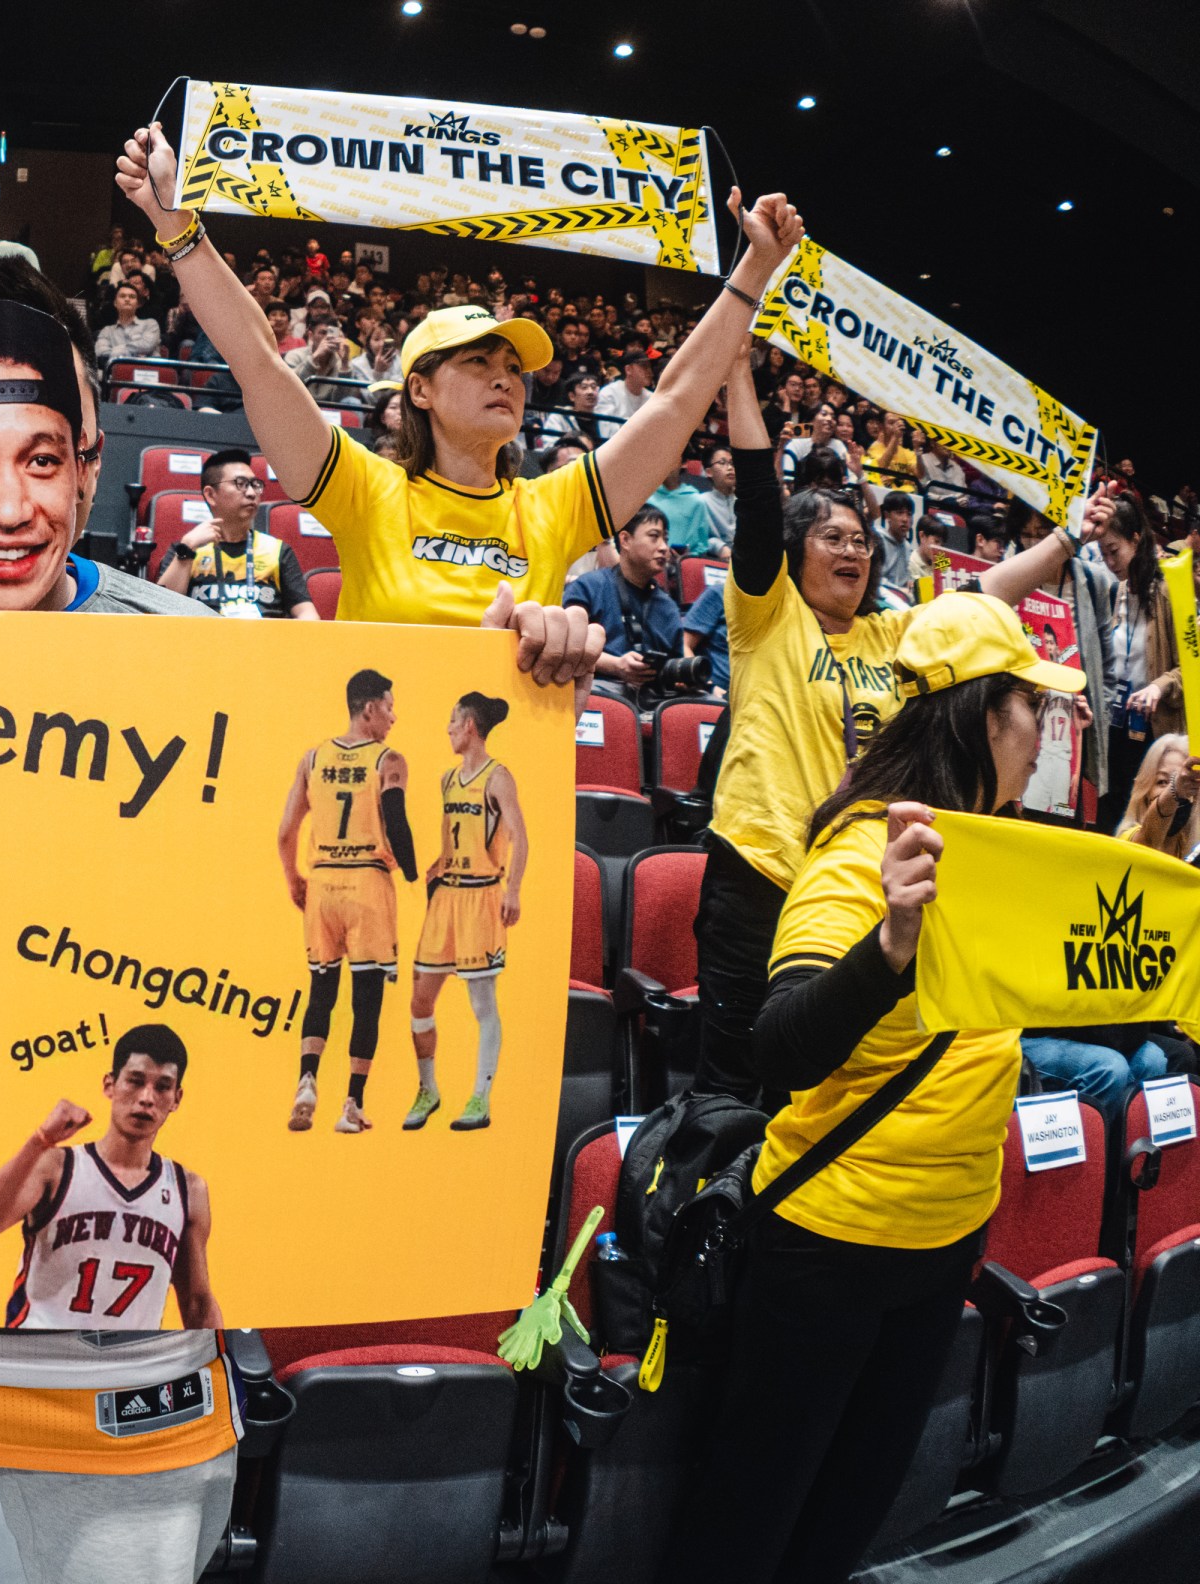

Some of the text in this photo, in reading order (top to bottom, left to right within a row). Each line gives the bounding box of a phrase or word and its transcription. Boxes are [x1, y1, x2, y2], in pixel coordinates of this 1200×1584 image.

[404, 124, 501, 146] KINGS
[208, 129, 686, 210] CROWN THE CITY
[913, 335, 974, 380] KINGS
[784, 278, 1077, 479] CROWN THE CITY
[444, 533, 509, 551] NEW TAIPEI
[412, 535, 529, 578] KINGS
[1023, 597, 1066, 619] JEREMY LIN
[578, 720, 599, 729] RVED
[1051, 715, 1066, 742] 17
[336, 791, 353, 839] 7
[452, 821, 460, 849] 1
[1070, 923, 1171, 942] NEW TAIPEI
[1063, 941, 1177, 993] KINGS
[10, 1012, 112, 1072] goat!
[1166, 1097, 1177, 1106] JAY
[1044, 1113, 1058, 1125] JAY
[1153, 1108, 1192, 1124] WASHINGTON
[1027, 1125, 1079, 1144] WASHINGTON
[52, 1210, 179, 1270] NEW YORK
[69, 1257, 155, 1318] 17
[182, 1386, 196, 1398] XL
[121, 1405, 152, 1417] adidas
